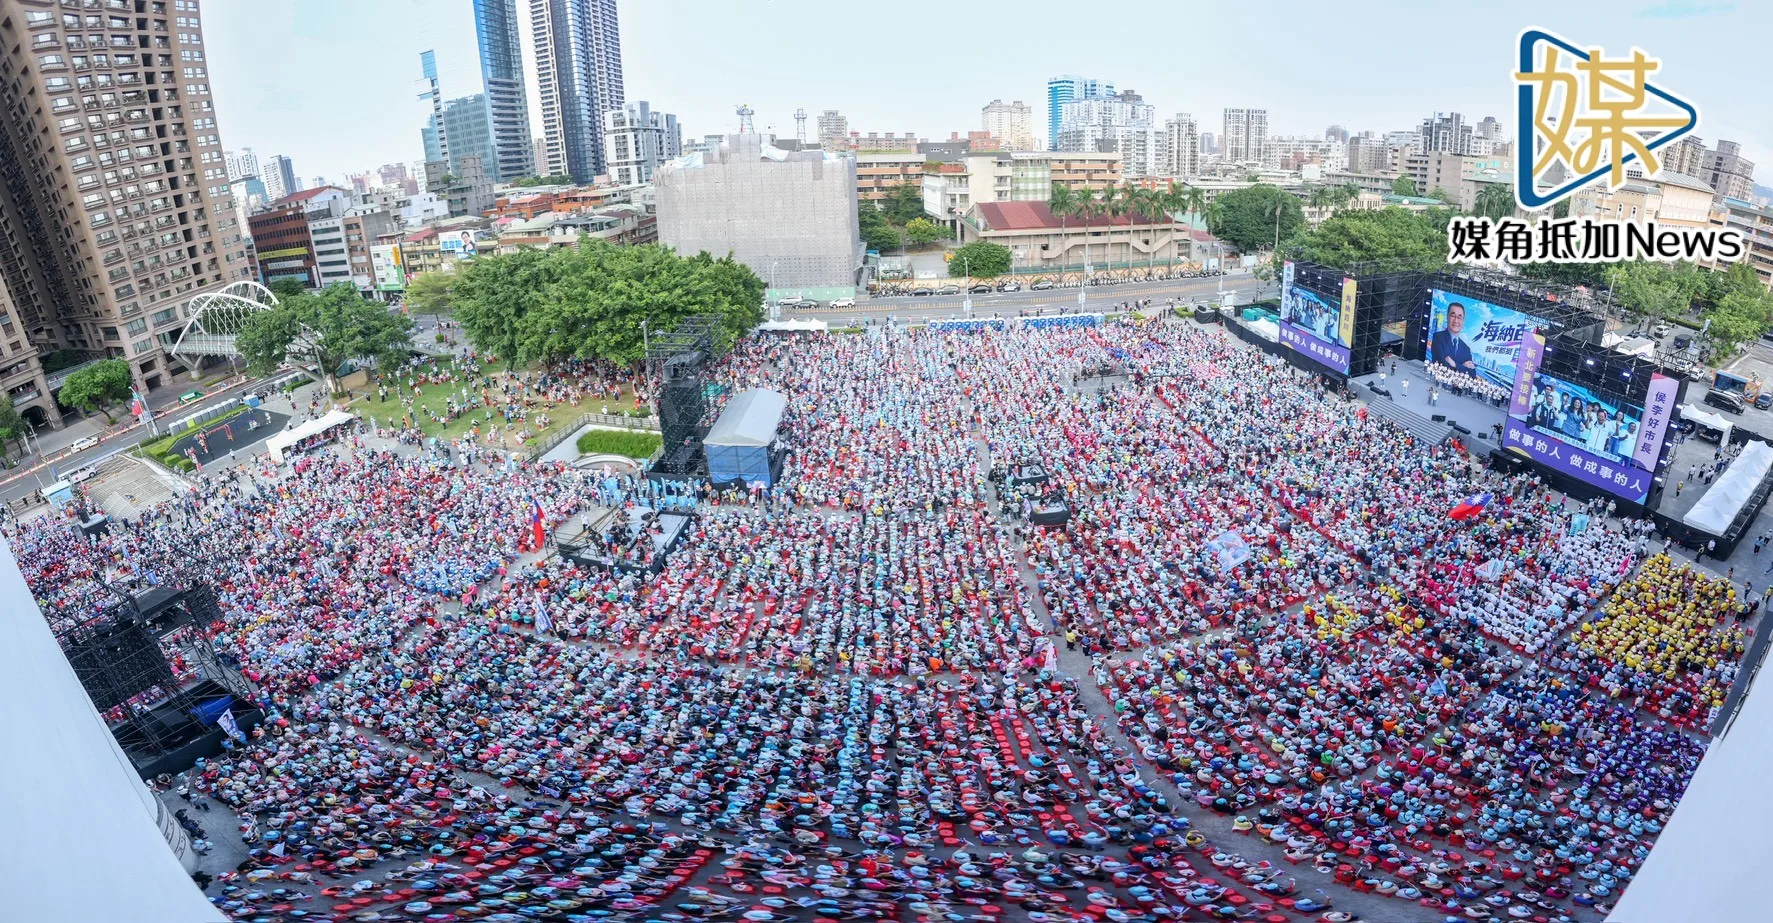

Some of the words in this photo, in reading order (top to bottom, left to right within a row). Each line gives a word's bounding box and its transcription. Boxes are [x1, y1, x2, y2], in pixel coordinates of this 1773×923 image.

[1281, 328, 1307, 348] 做事的人
[1310, 343, 1347, 366] 做成事的人
[1517, 348, 1537, 406] 新北要接棒
[1640, 391, 1667, 455] 侯李好市長
[1509, 428, 1561, 460] 做事的人
[1569, 453, 1643, 493] 做成事的人
